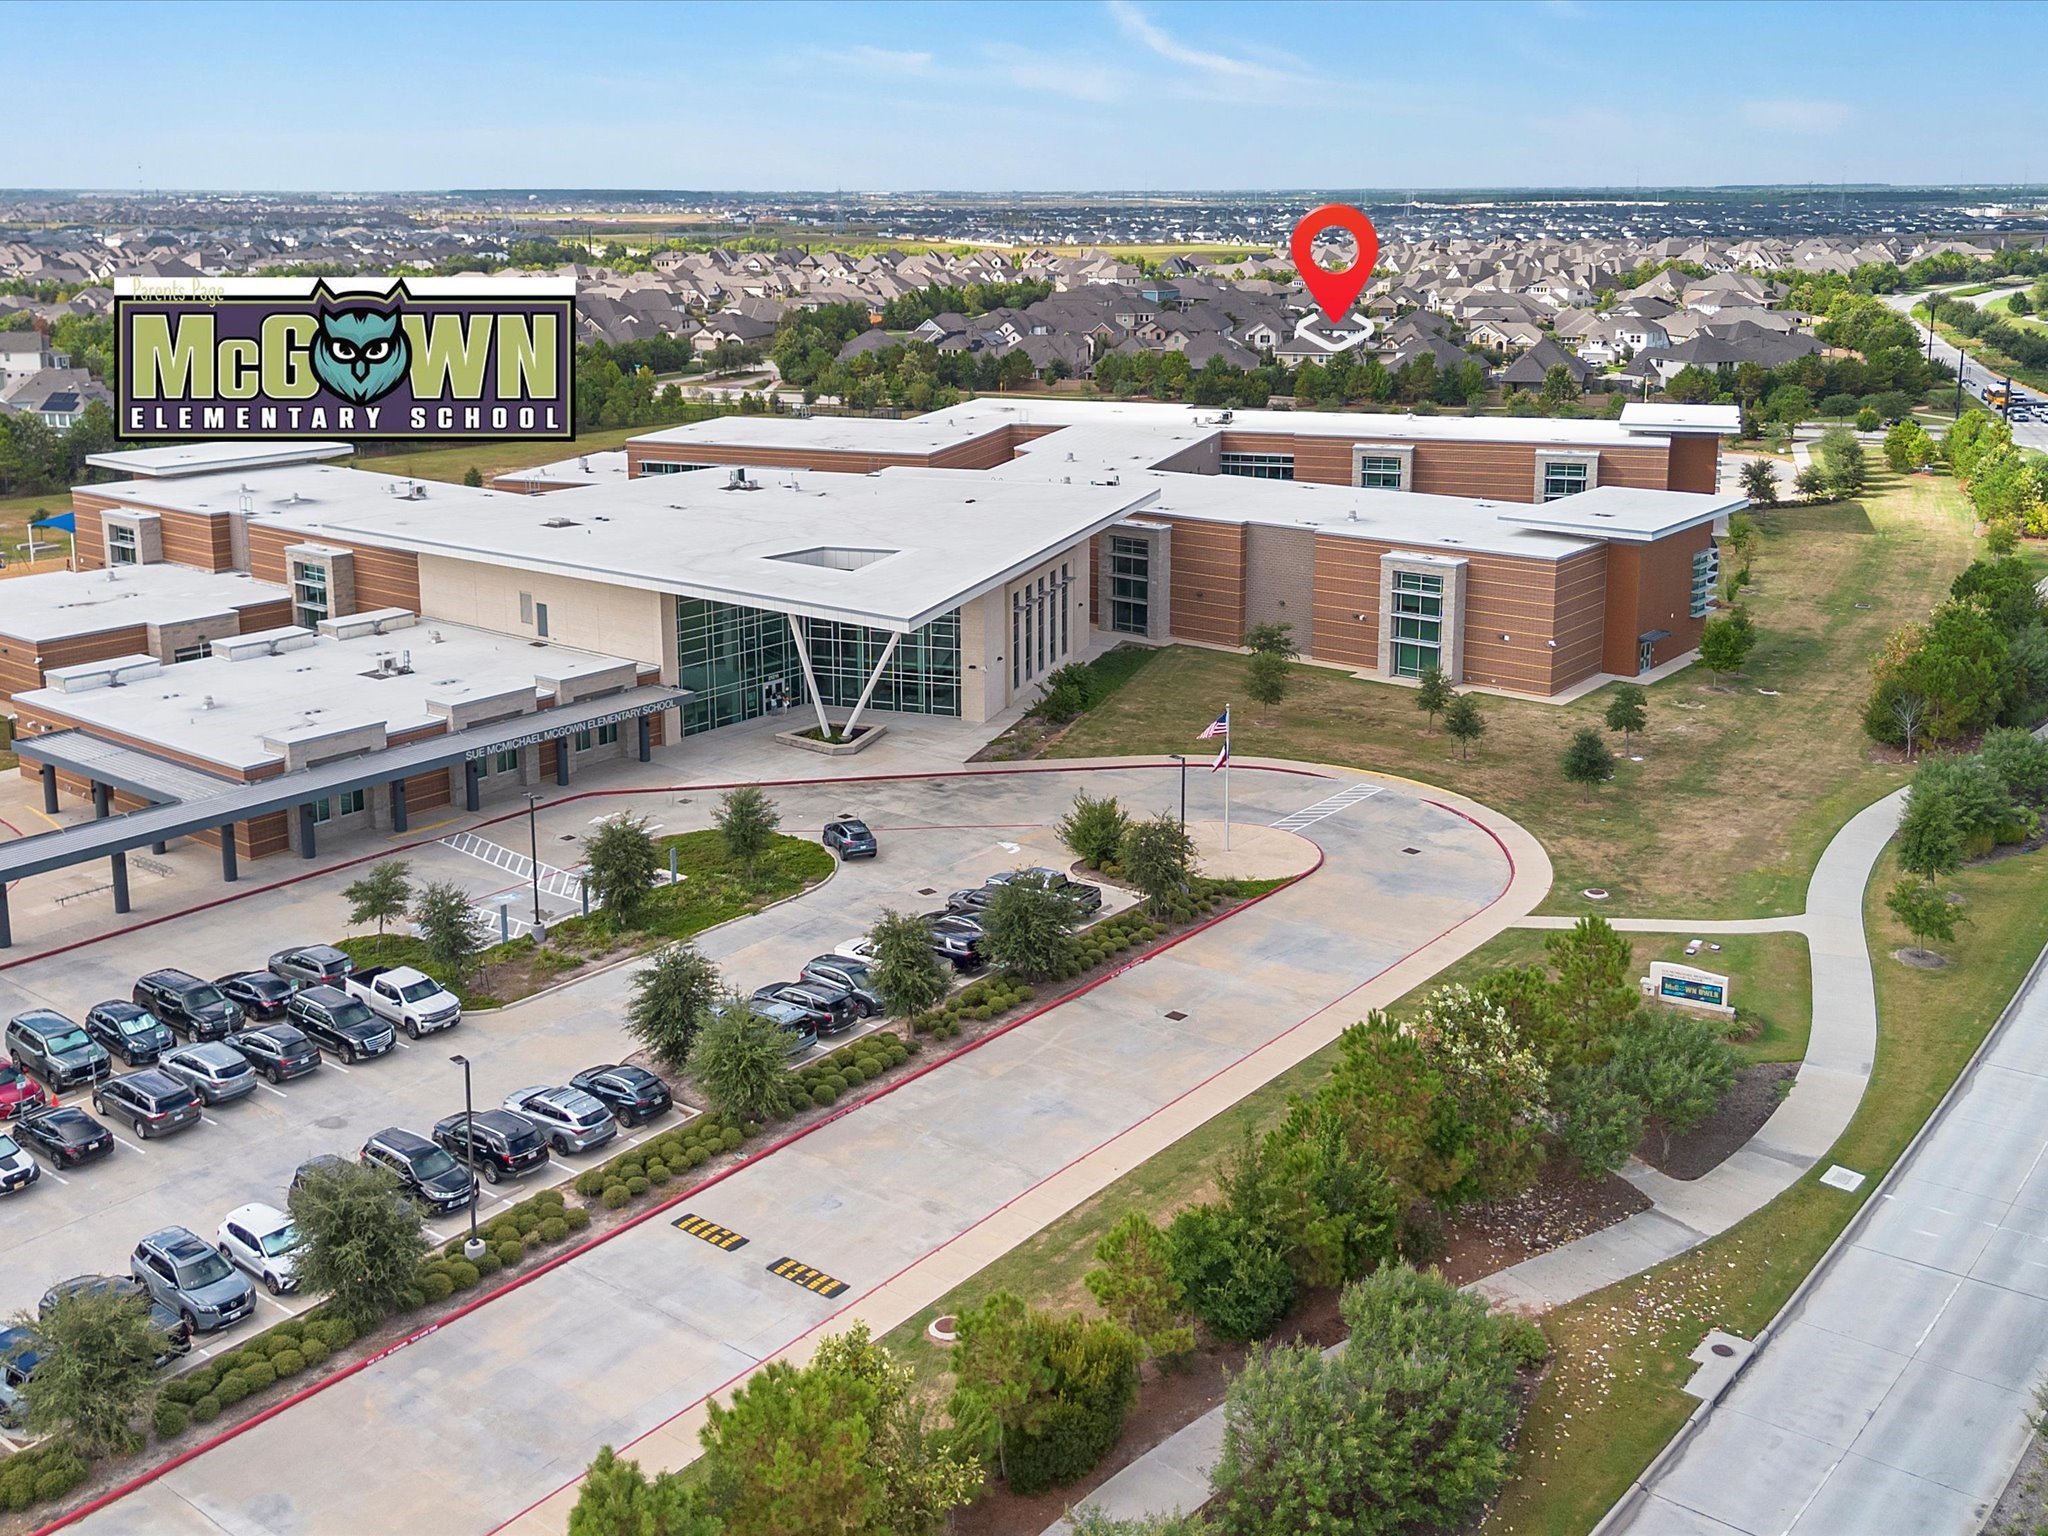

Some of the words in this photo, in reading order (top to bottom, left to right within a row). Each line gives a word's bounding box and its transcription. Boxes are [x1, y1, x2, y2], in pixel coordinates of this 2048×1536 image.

[465, 748, 486, 761] SUE
[486, 735, 543, 755] MCMICHAEL
[544, 721, 586, 740] MCGOWN
[587, 707, 641, 730] ELEMENTARY
[642, 699, 676, 715] SCHOOL
